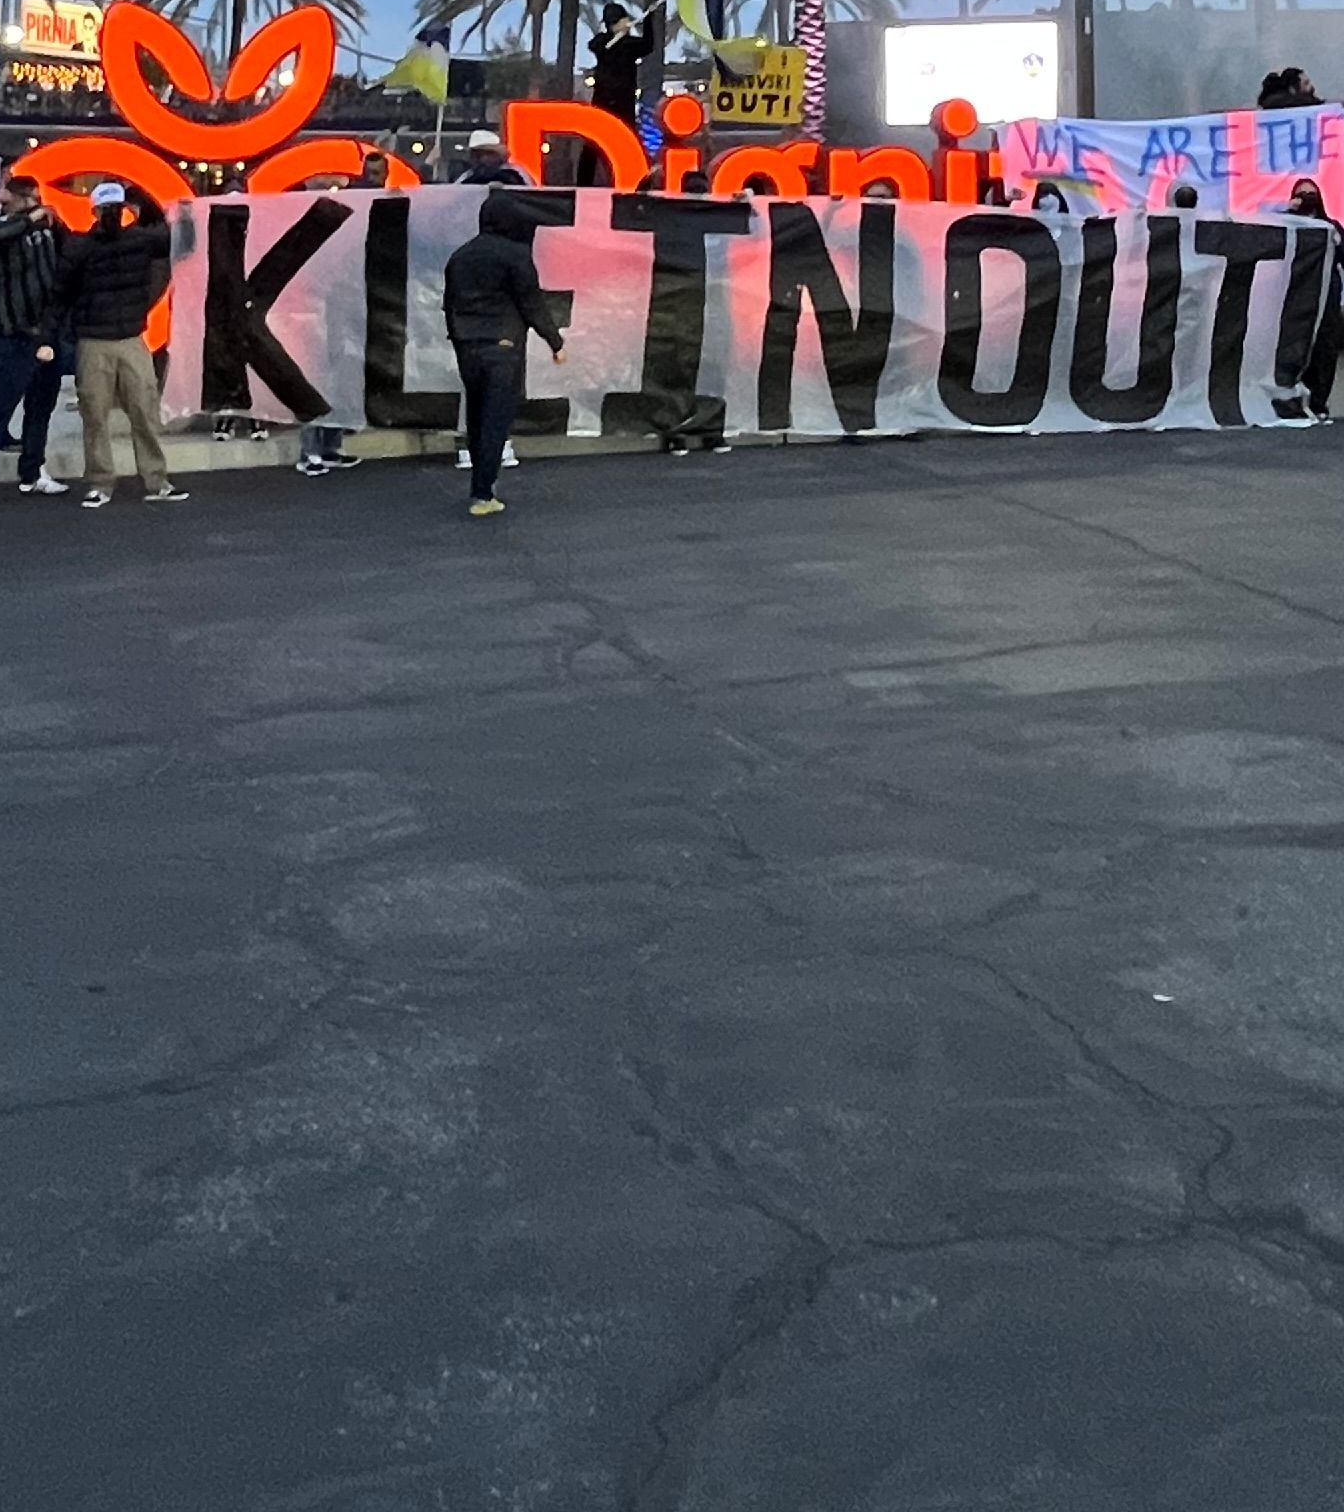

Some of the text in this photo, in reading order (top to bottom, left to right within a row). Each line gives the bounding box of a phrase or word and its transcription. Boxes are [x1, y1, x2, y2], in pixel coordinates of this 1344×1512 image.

[26, 12, 77, 44] PIRNIA
[716, 91, 791, 117] OUT!
[1014, 118, 1107, 176] WE
[1138, 124, 1242, 183] ARE
[940, 214, 1335, 428] OUT!
